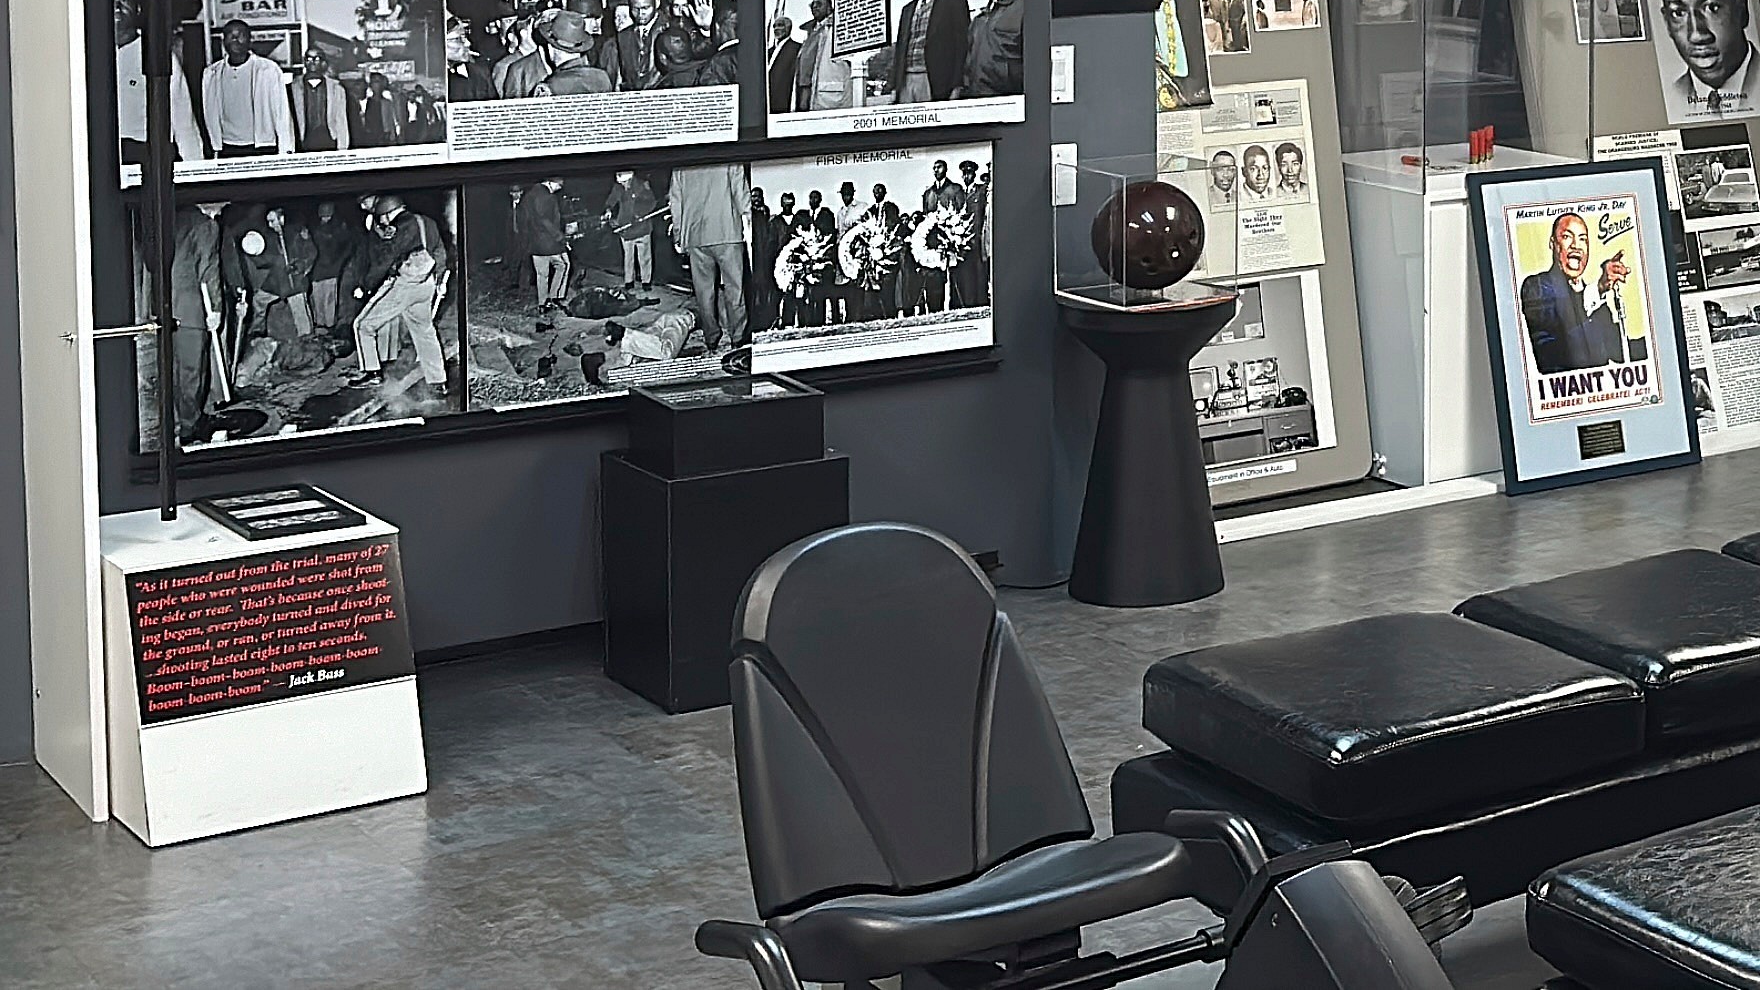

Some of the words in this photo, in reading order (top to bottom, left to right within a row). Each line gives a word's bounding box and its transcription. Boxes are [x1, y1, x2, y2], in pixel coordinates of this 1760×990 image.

[241, 0, 287, 11] BAR
[853, 117, 877, 130] 2001
[881, 113, 942, 128] MEMORIAL
[816, 154, 850, 167] FIRST
[853, 149, 914, 164] MEMORIAL
[1516, 210, 1544, 219] MARTIN
[1577, 204, 1596, 213] KING
[1598, 213, 1631, 240] Serve
[1538, 379, 1546, 400] I
[1549, 371, 1604, 398] WANT
[1608, 365, 1648, 389] YOU
[159, 580, 168, 591] it
[172, 572, 213, 587] turned
[216, 569, 236, 581] out
[238, 564, 267, 580] from
[271, 561, 289, 572] the
[326, 551, 357, 563] many
[361, 546, 373, 560] of
[137, 594, 177, 614] people
[181, 591, 206, 603] who
[209, 587, 237, 599] were
[241, 575, 294, 593] wounded
[298, 572, 325, 584] were
[328, 567, 352, 579] shot
[354, 563, 383, 578] from
[139, 615, 158, 627] the
[162, 610, 185, 623] side
[189, 609, 202, 619] or
[278, 589, 325, 604] because
[326, 585, 354, 596] once
[141, 633, 161, 645] ing
[207, 614, 270, 633] everybody
[272, 605, 312, 622] turned
[315, 601, 338, 614] and
[340, 597, 372, 610] dived
[374, 594, 392, 607] for
[143, 649, 162, 660] the
[217, 638, 229, 648] or
[261, 631, 274, 641] or
[278, 621, 317, 637] turned
[319, 617, 351, 630] away
[354, 613, 382, 629] from
[212, 650, 247, 665] lasted
[251, 645, 280, 661] eight
[284, 643, 294, 653] to
[297, 641, 316, 651] ten
[288, 671, 314, 688] Jack
[317, 668, 345, 682] Bass
